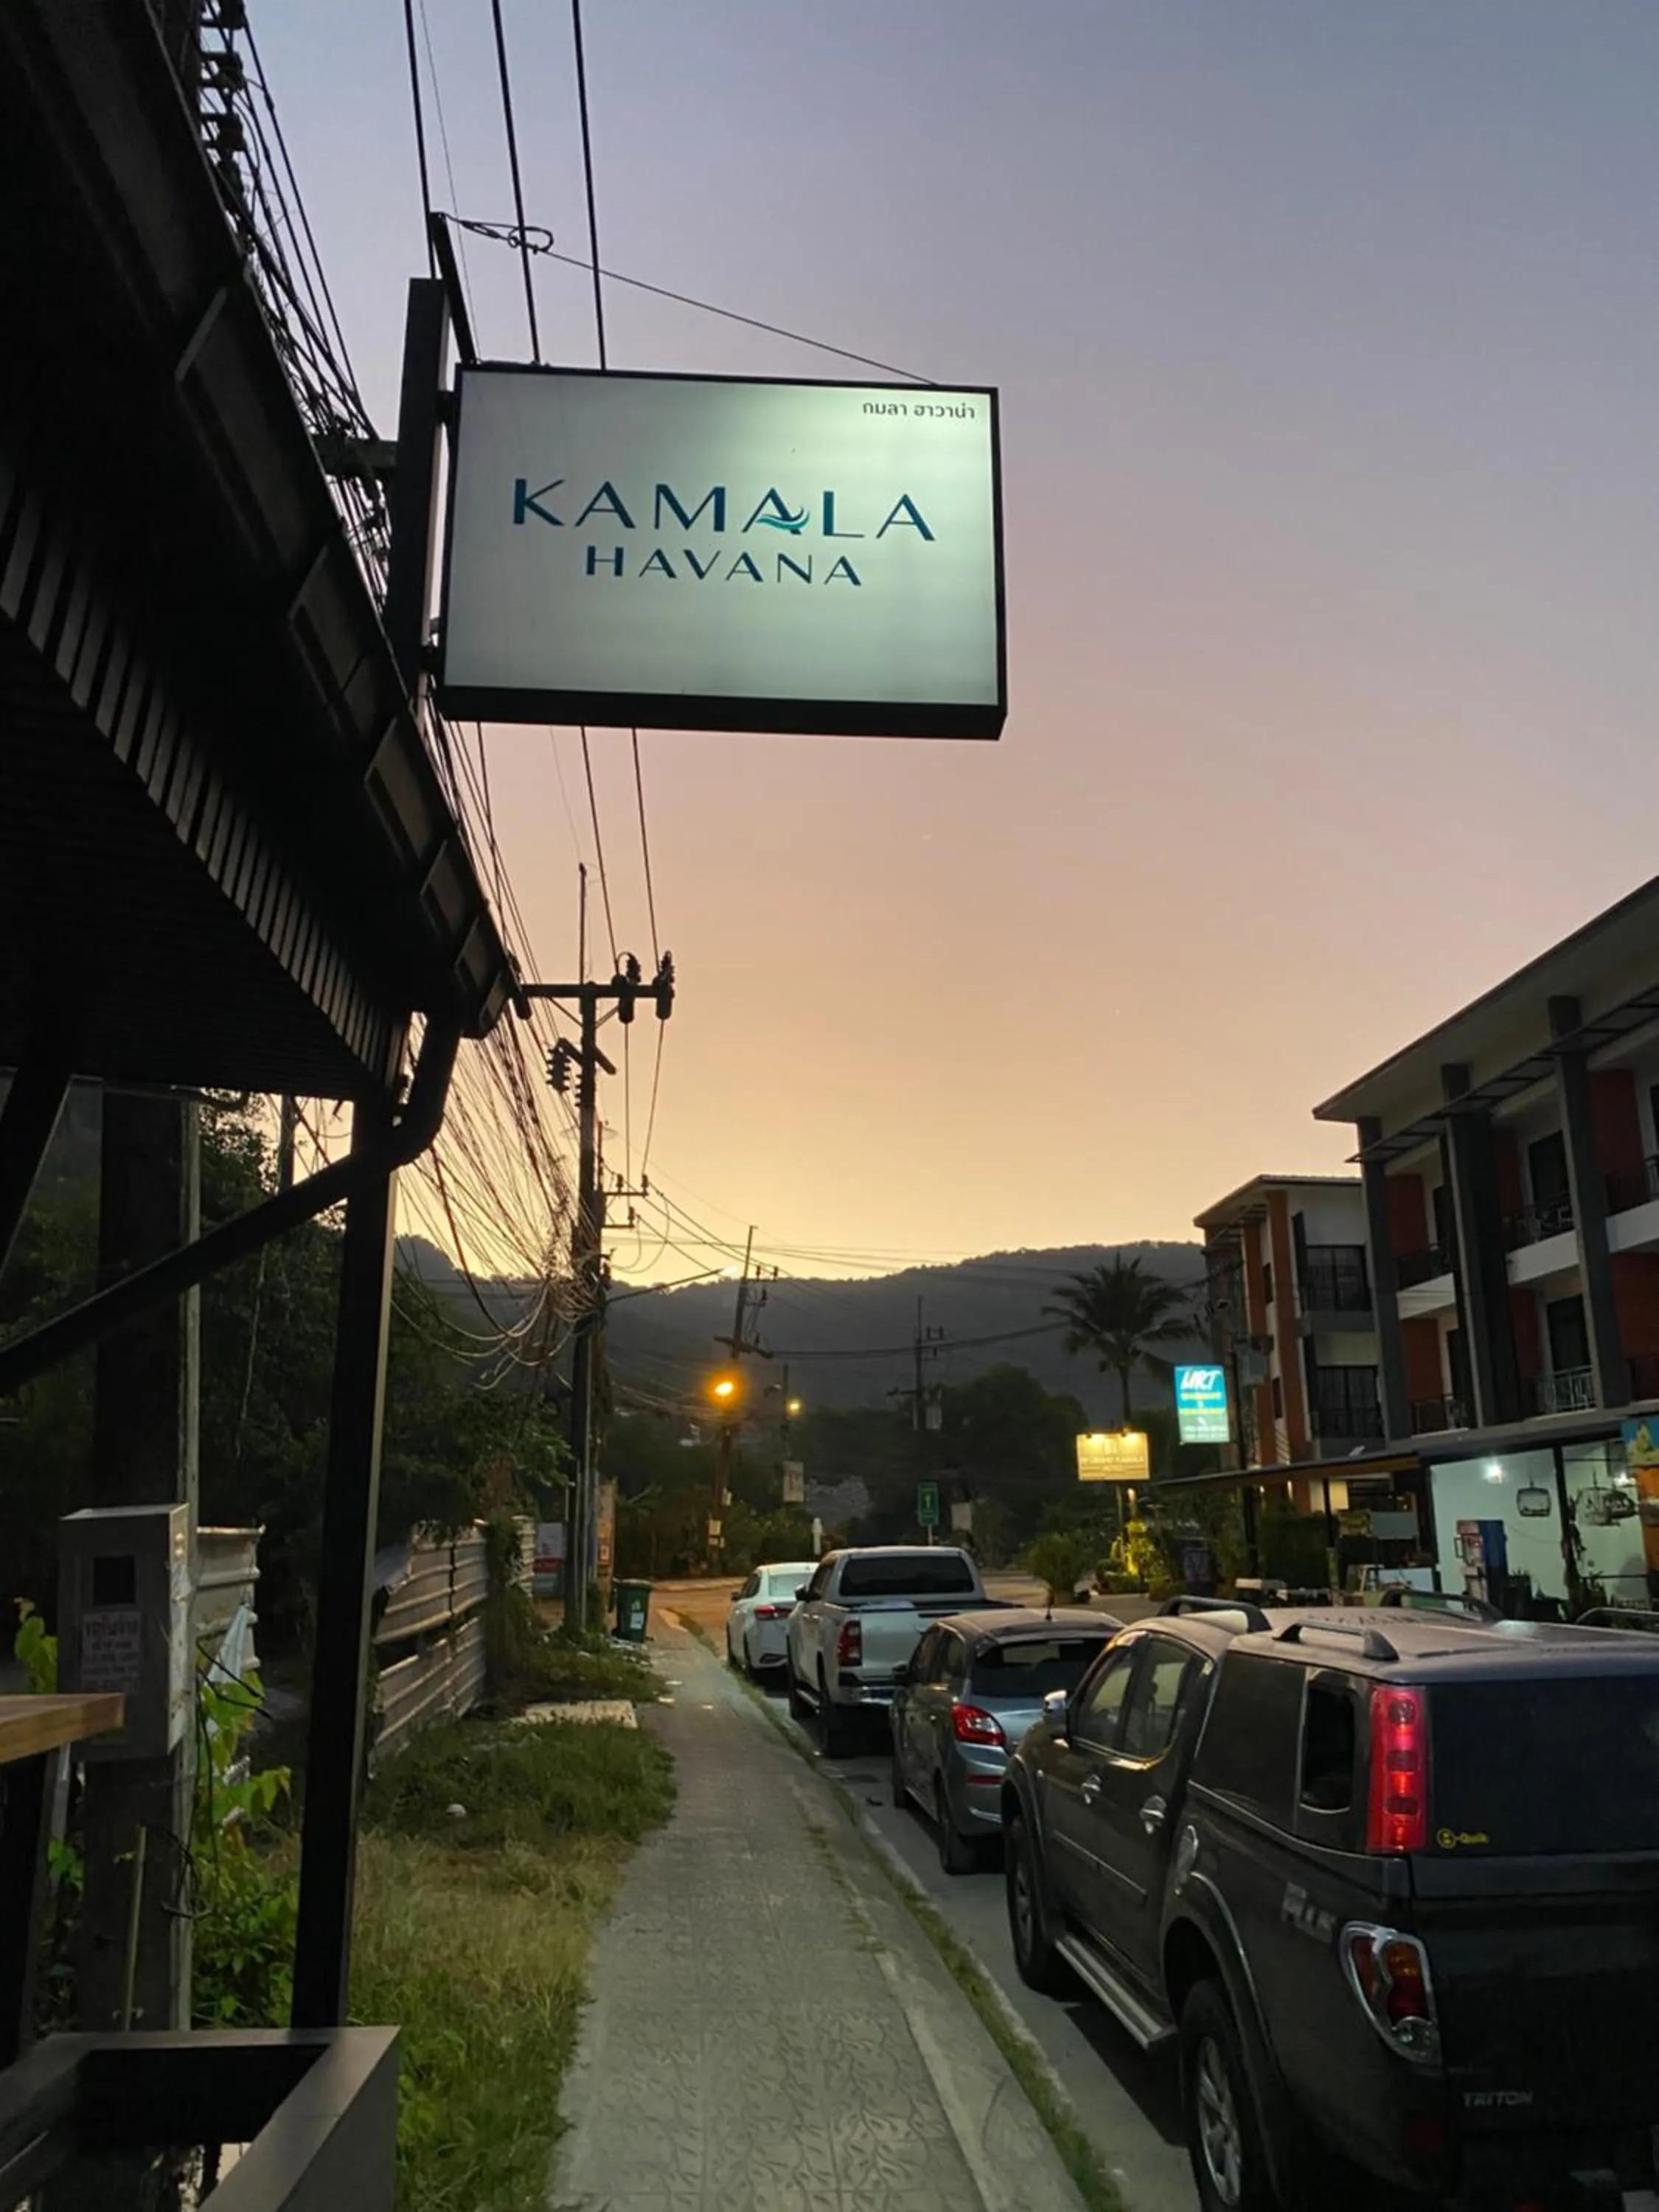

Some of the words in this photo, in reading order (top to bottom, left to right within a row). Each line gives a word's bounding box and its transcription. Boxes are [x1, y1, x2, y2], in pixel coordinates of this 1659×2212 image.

[862, 402, 908, 417] กมลา
[914, 403, 975, 420] ฮาวาน่า
[512, 478, 936, 542] KAMALA
[585, 544, 862, 586] HAVANA
[1462, 2089, 1534, 2109] TRITON
